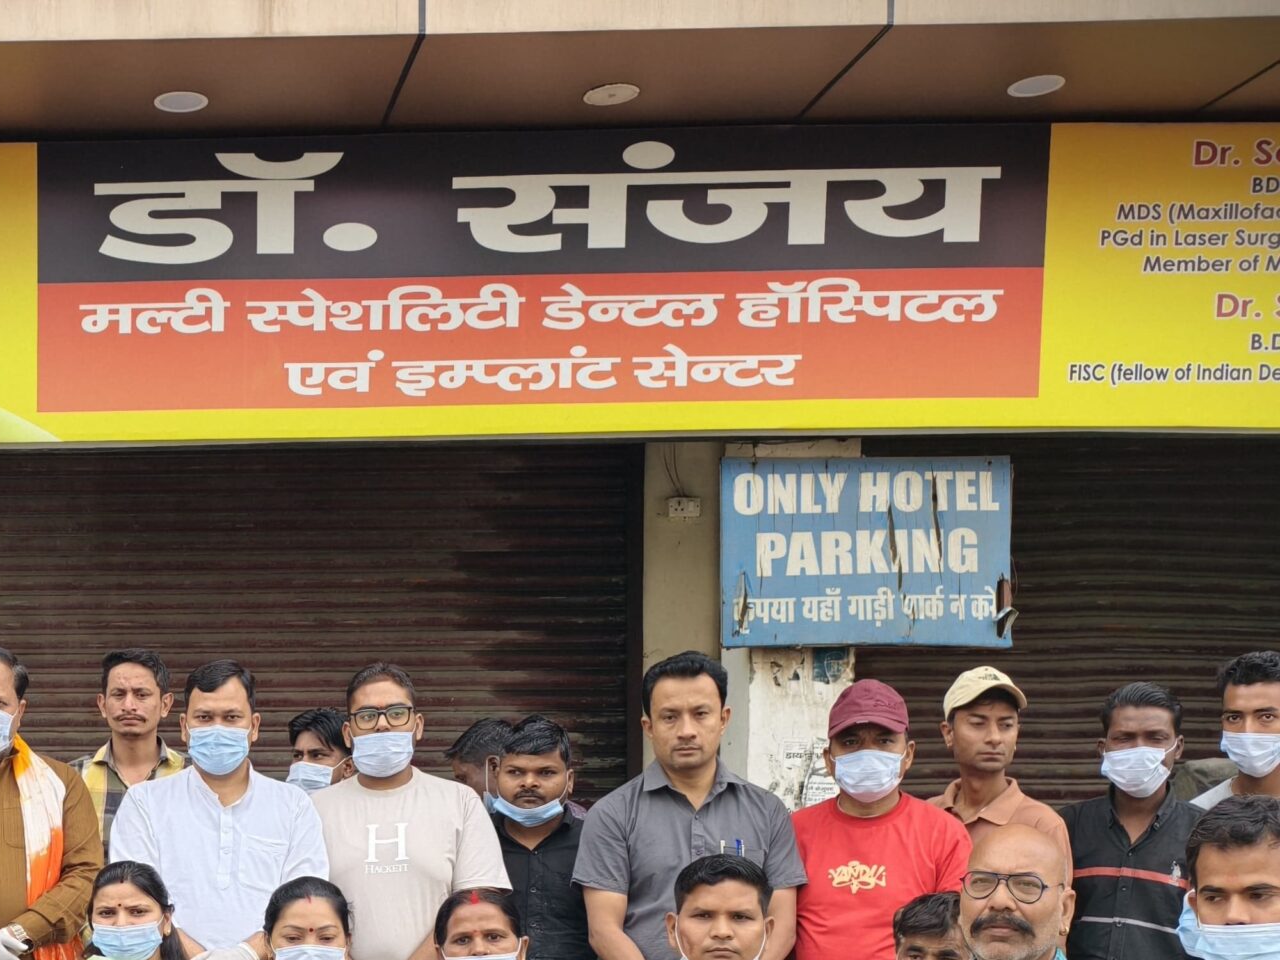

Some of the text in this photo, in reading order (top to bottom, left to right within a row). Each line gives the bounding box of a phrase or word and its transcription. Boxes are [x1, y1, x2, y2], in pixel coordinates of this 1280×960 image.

[1193, 139, 1280, 166] Dr. S
[94, 141, 1002, 265] डॉ. संजय
[1117, 204, 1162, 220] MDS
[1101, 230, 1143, 246] PGd
[1150, 230, 1167, 246] in
[1174, 230, 1228, 246] Laser
[1143, 256, 1232, 272] Member
[1239, 255, 1260, 272] of
[79, 277, 1004, 334] मल्टी स्पेशलिटी डेन्टल हॉस्पिटल
[1216, 293, 1261, 318] Dr.
[284, 343, 802, 397] एवं इम्प्लांट सेन्टर
[1069, 364, 1105, 380] FISC
[1110, 363, 1169, 386] (fellow
[1175, 363, 1192, 381] of
[1197, 363, 1252, 380] Indian
[733, 470, 1000, 516] ONLY HOTEL
[756, 528, 978, 577] PARKING
[847, 587, 895, 627] गाड़ी
[950, 594, 967, 620] न
[364, 822, 409, 862] H
